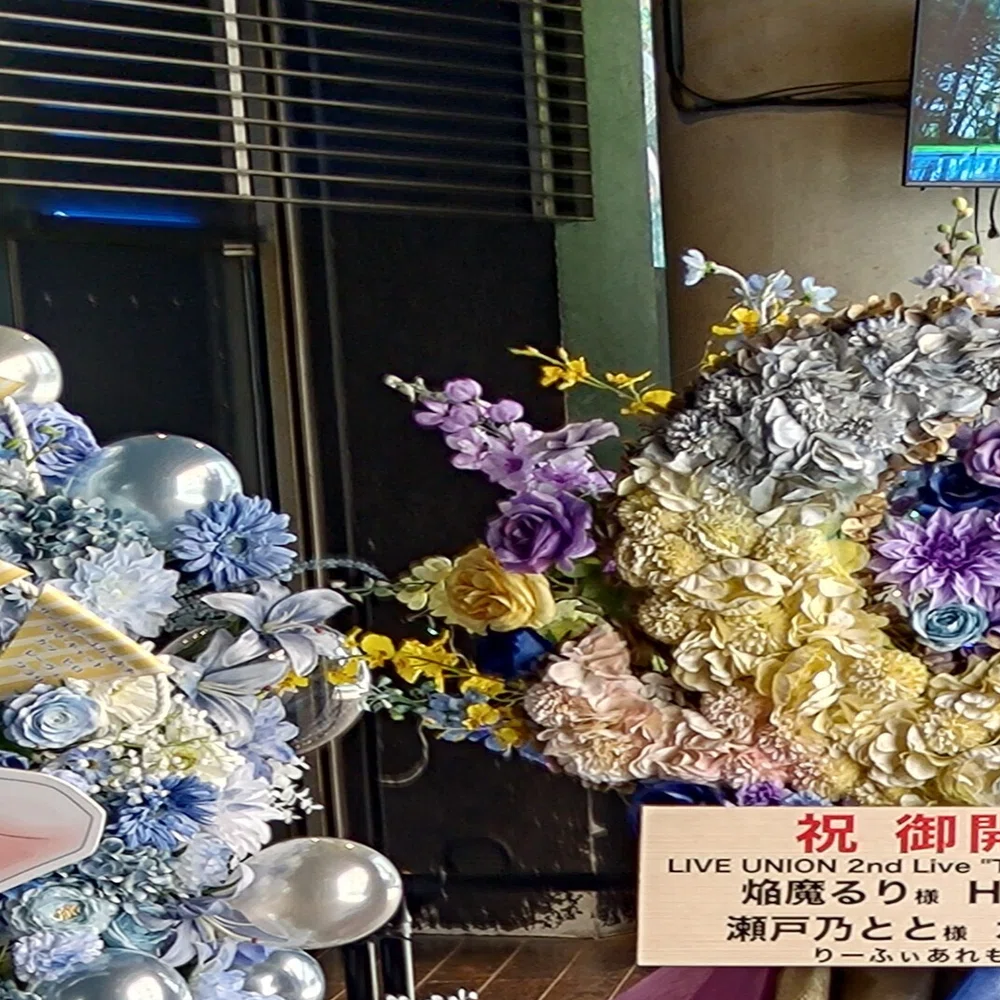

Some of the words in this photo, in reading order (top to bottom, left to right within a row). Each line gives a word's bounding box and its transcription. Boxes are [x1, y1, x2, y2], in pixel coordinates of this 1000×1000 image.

[795, 812, 858, 854] 祝
[668, 858, 731, 873] LIVE
[741, 858, 837, 873] UNION
[848, 858, 901, 873] 2nd
[913, 858, 971, 873] Live
